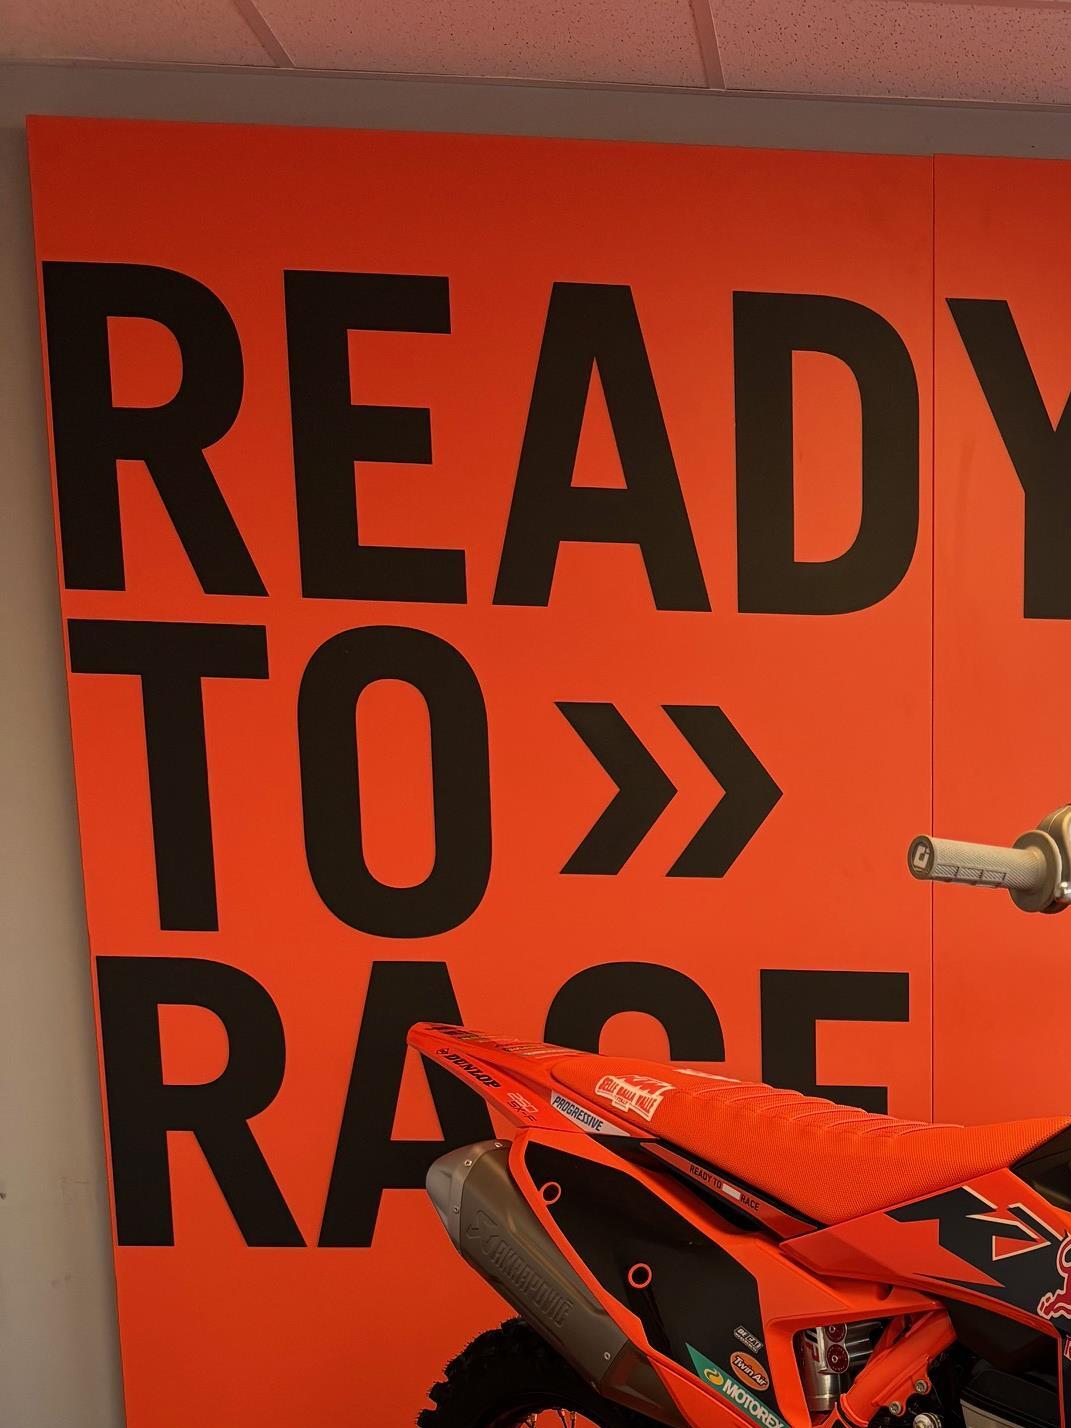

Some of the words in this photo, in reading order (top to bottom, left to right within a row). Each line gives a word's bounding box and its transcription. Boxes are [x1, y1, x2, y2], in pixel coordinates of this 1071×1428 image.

[67, 617, 493, 939] TO
[444, 1053, 502, 1089] DUNLOP
[553, 1096, 604, 1132] PROGRESSIVE
[689, 1164, 712, 1183] READY
[740, 1194, 760, 1212] RACE
[734, 1356, 755, 1380] Twin
[752, 1373, 768, 1387] Air
